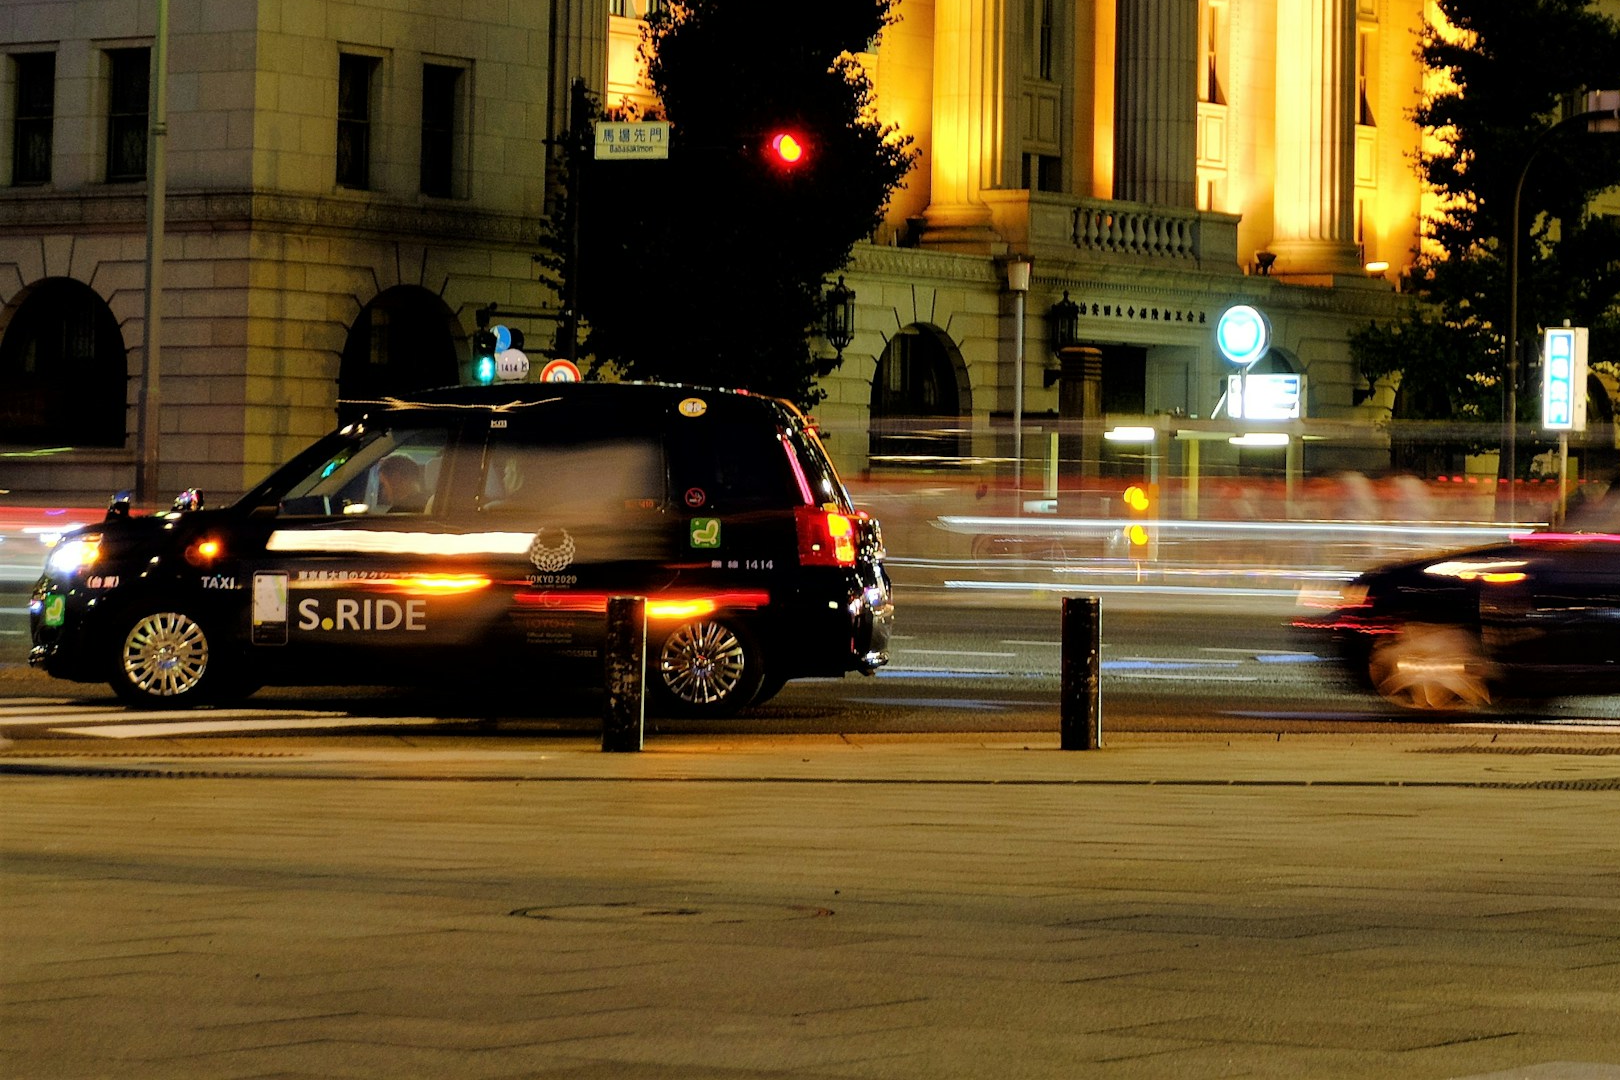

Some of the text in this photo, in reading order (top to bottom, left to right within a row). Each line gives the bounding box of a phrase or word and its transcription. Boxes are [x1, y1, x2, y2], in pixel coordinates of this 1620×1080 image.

[602, 127, 662, 143] 馬場先門
[609, 144, 654, 154] Babasakimon
[1078, 302, 1206, 324] 治安田生命保険相互会社
[501, 363, 518, 372] 1414
[745, 559, 774, 570] 1414
[201, 575, 235, 589] TAXI
[526, 575, 577, 585] TOKYO 2020
[298, 598, 427, 631] S.RIDE
